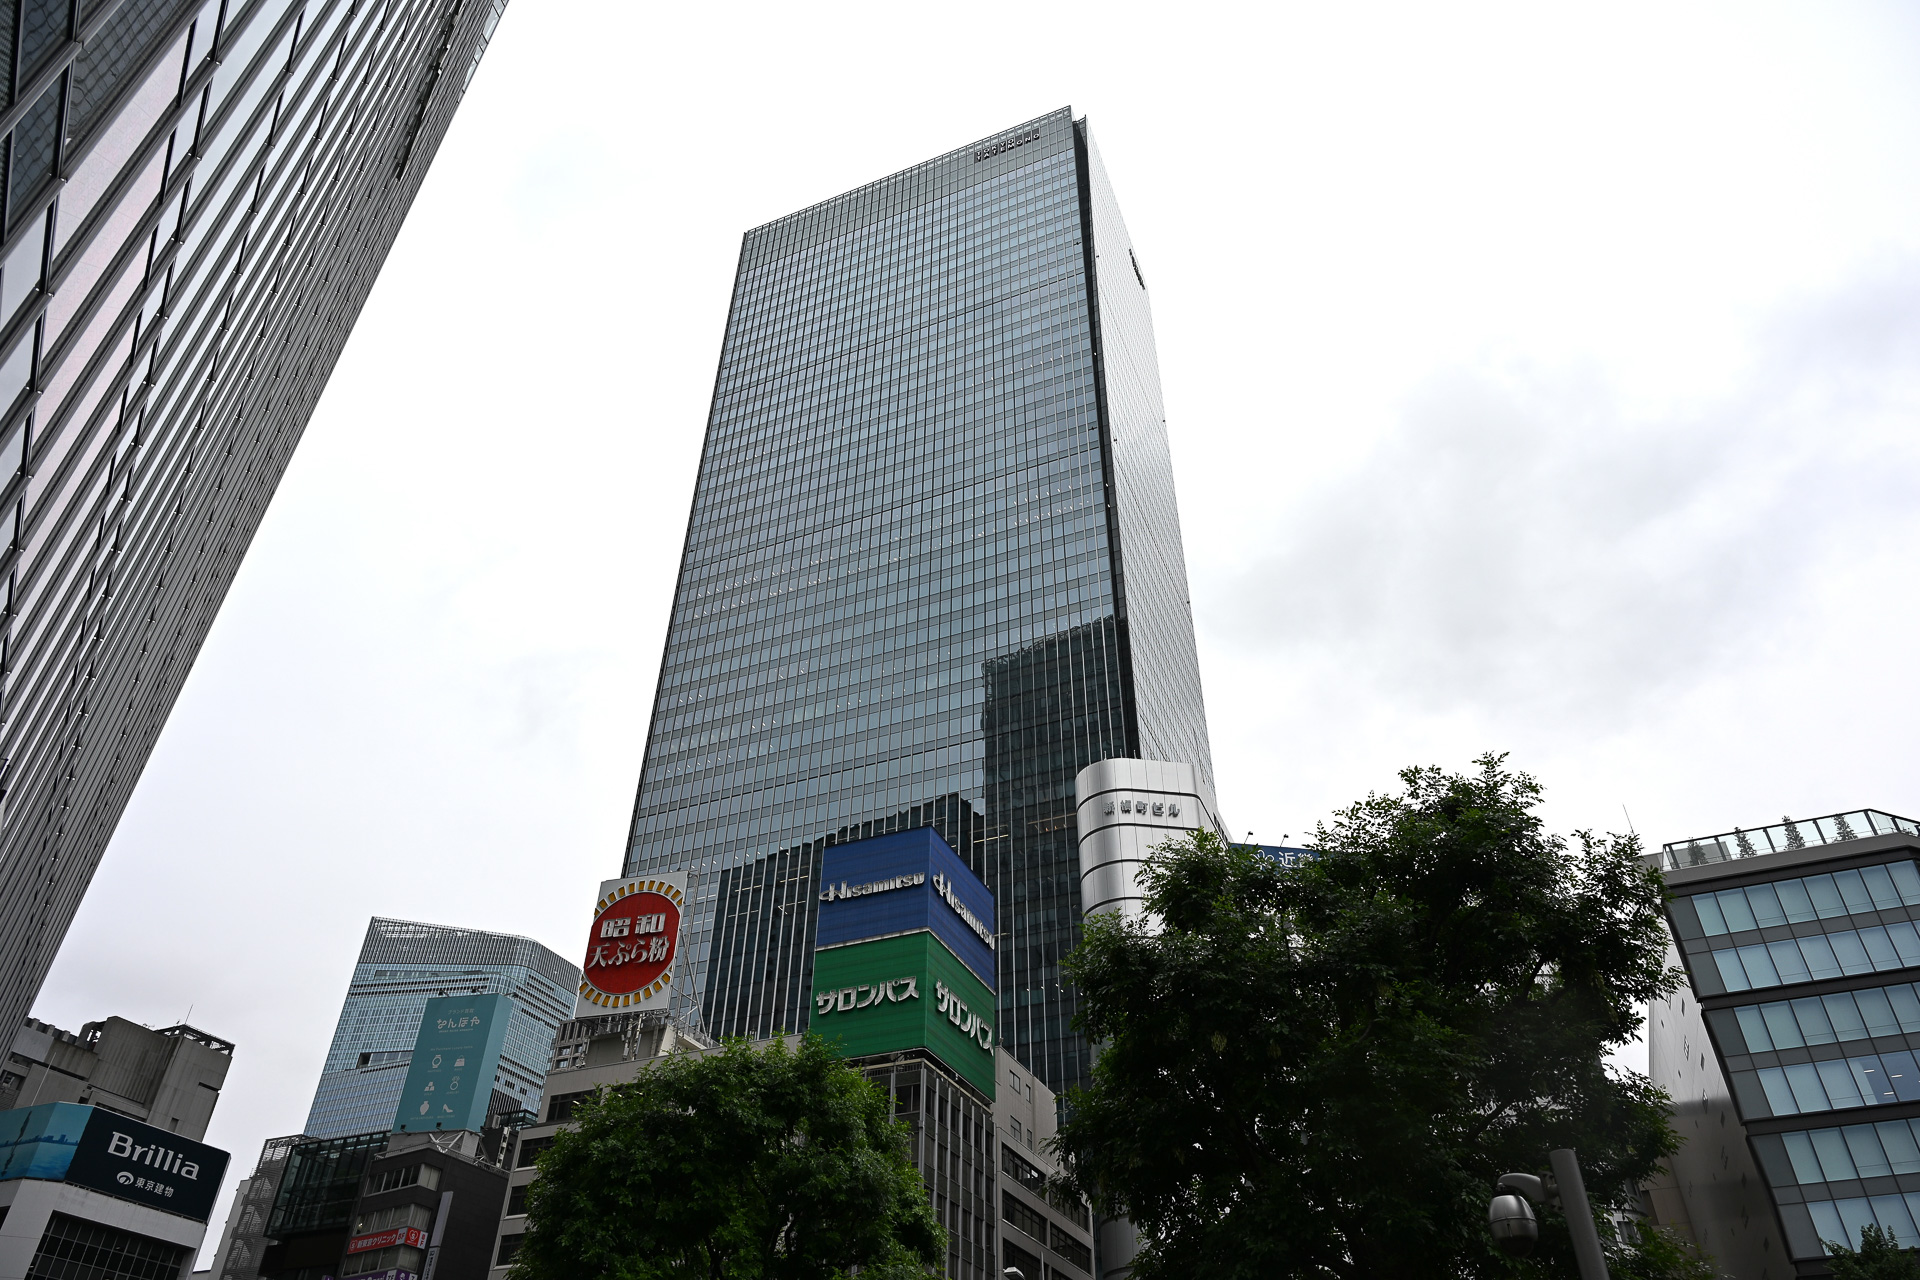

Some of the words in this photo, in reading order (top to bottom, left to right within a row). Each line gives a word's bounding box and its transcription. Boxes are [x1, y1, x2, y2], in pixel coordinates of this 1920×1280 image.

[976, 139, 1014, 156] TOKYO
[976, 133, 1039, 162] TATEMONO
[819, 872, 925, 901] Hisamitsu
[932, 870, 995, 950] Hisamitsu
[600, 913, 666, 938] 昭和
[586, 936, 670, 969] 天ぷら粉
[816, 976, 919, 1015] サロンパス
[437, 1016, 480, 1030] なんぼや
[935, 979, 994, 1056] サロンパス
[107, 1131, 200, 1180] Brillia
[134, 1177, 174, 1198] 東京建物
